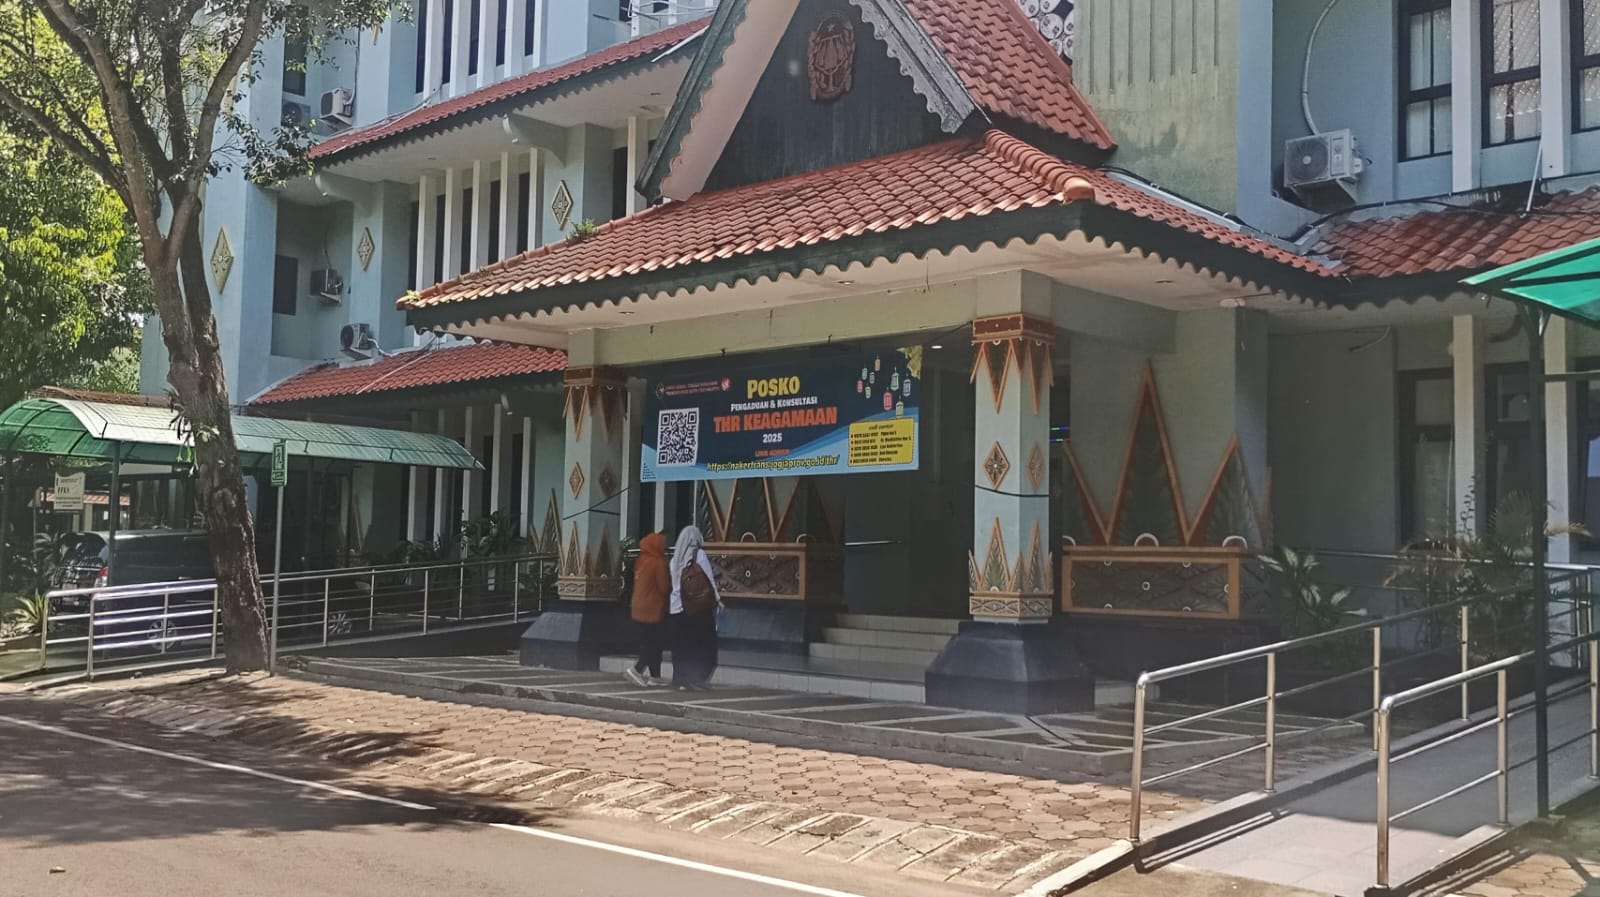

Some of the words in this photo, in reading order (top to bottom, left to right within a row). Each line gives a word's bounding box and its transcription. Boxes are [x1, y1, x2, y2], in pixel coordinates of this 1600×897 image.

[747, 376, 800, 399] POSKO
[731, 400, 769, 412] PENGADUAN
[770, 400, 776, 409] &
[777, 396, 818, 408] KONSULTASI
[714, 415, 740, 433] THR
[743, 406, 837, 431] KEAGAMAAN
[762, 433, 783, 443] 2025
